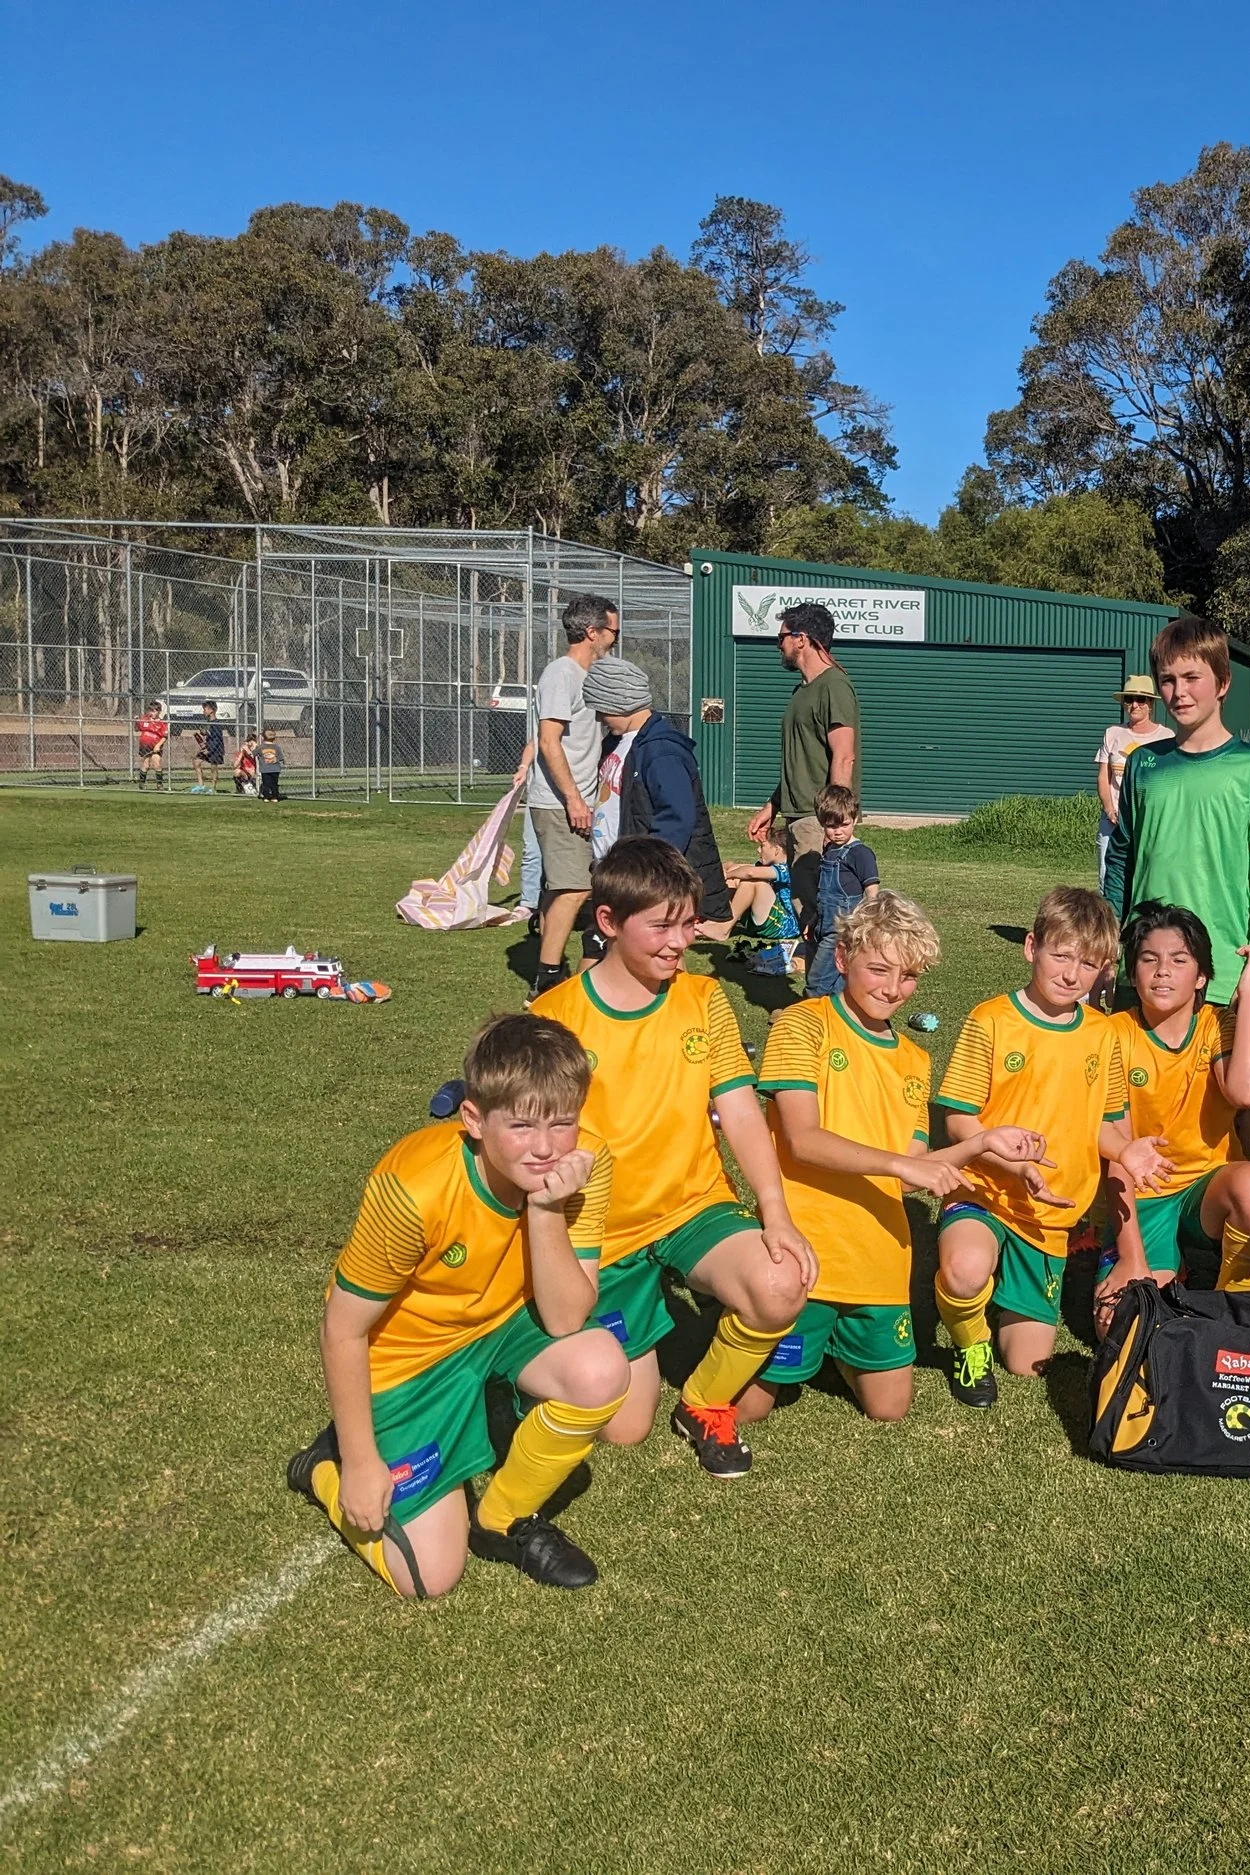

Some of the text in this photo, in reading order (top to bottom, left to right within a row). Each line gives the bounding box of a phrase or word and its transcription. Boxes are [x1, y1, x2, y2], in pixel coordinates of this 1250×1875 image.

[779, 596, 921, 610] MARGARET RIVER
[831, 610, 880, 621] AWKS
[865, 623, 905, 636] CLUB
[1211, 1381, 1250, 1393] MARGARET
[1218, 1417, 1248, 1442] MARGARET
[411, 1451, 439, 1472] Insurance
